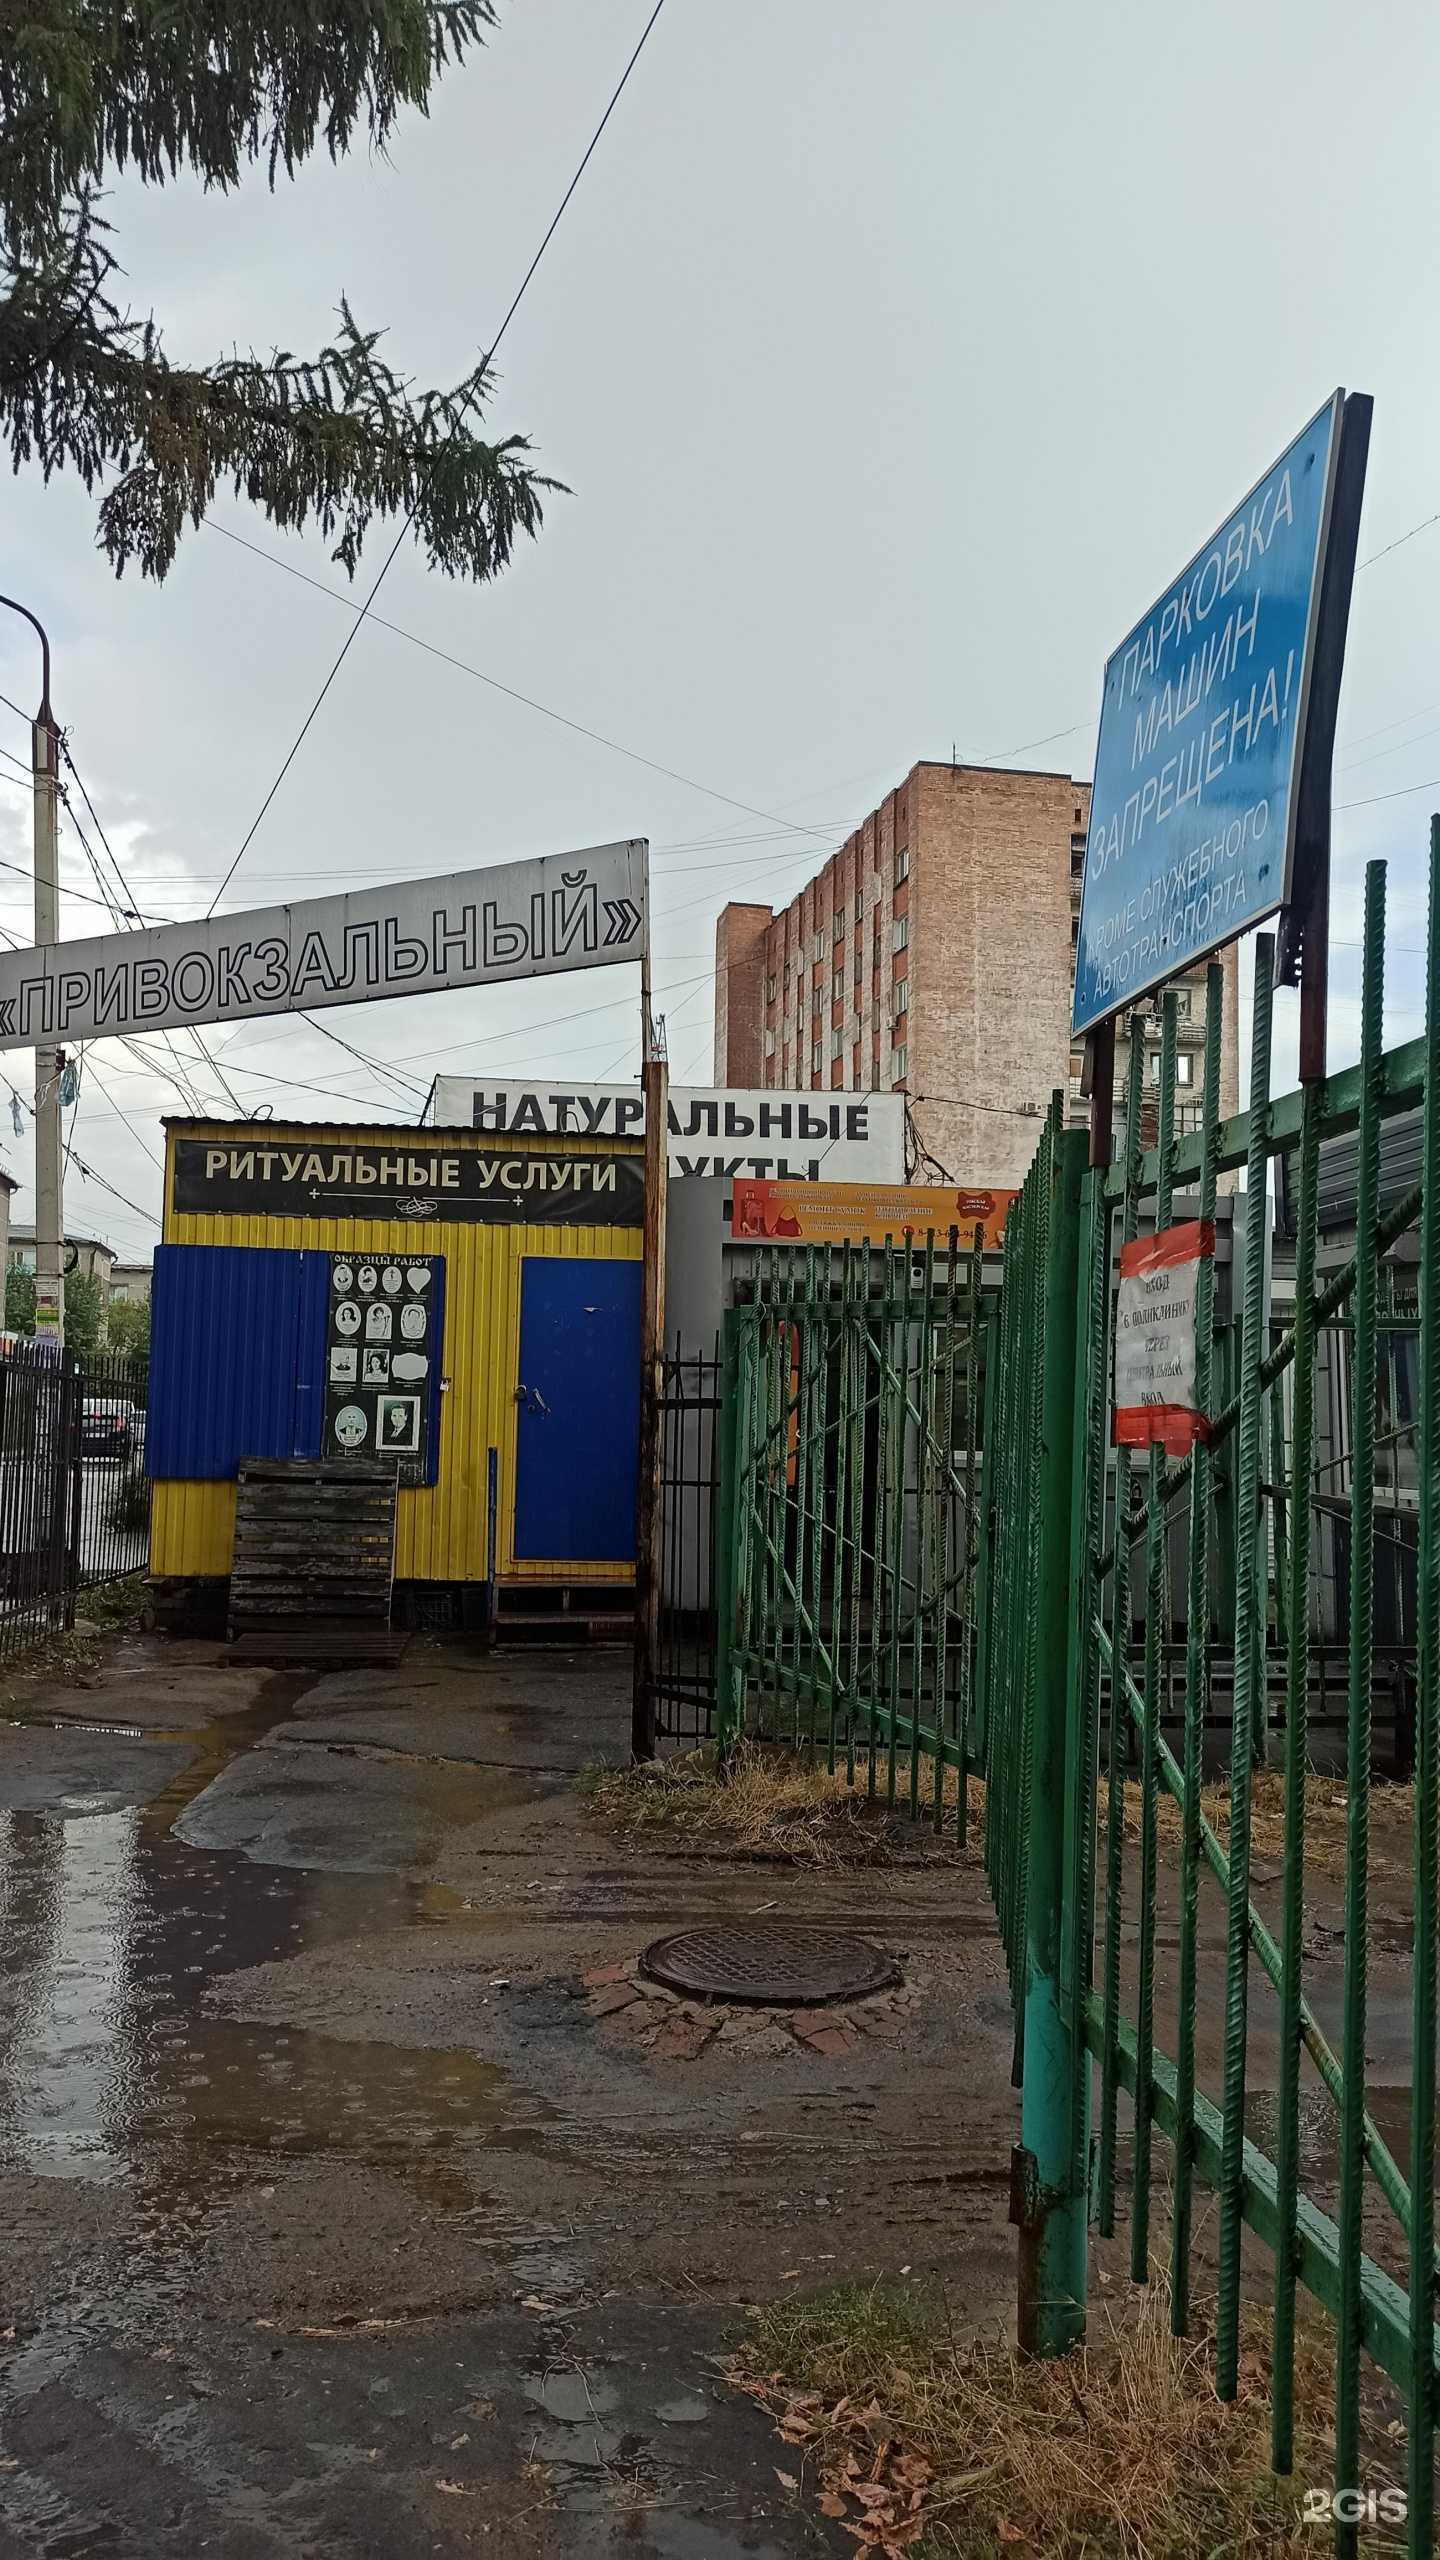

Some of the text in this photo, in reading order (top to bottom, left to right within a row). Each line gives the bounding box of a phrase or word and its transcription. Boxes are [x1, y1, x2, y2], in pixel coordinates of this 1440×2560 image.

[1118, 468, 1293, 711] ПАРКОВКА
[1131, 588, 1261, 772] МАШИН
[1092, 649, 1294, 881] ЗАПРЕЩЕНА!
[1140, 799, 1269, 921] СЛУЖЕБНОГО
[1093, 869, 1247, 1003] АВТОТРАНСПОРТА
[204, 1151, 617, 1192] РИТУАЛЬНЫЕ УСЛУГИ
[334, 1254, 432, 1266] ОБРАЗЦЫ РАБОТ
[1145, 1273, 1170, 1294] ВХОД
